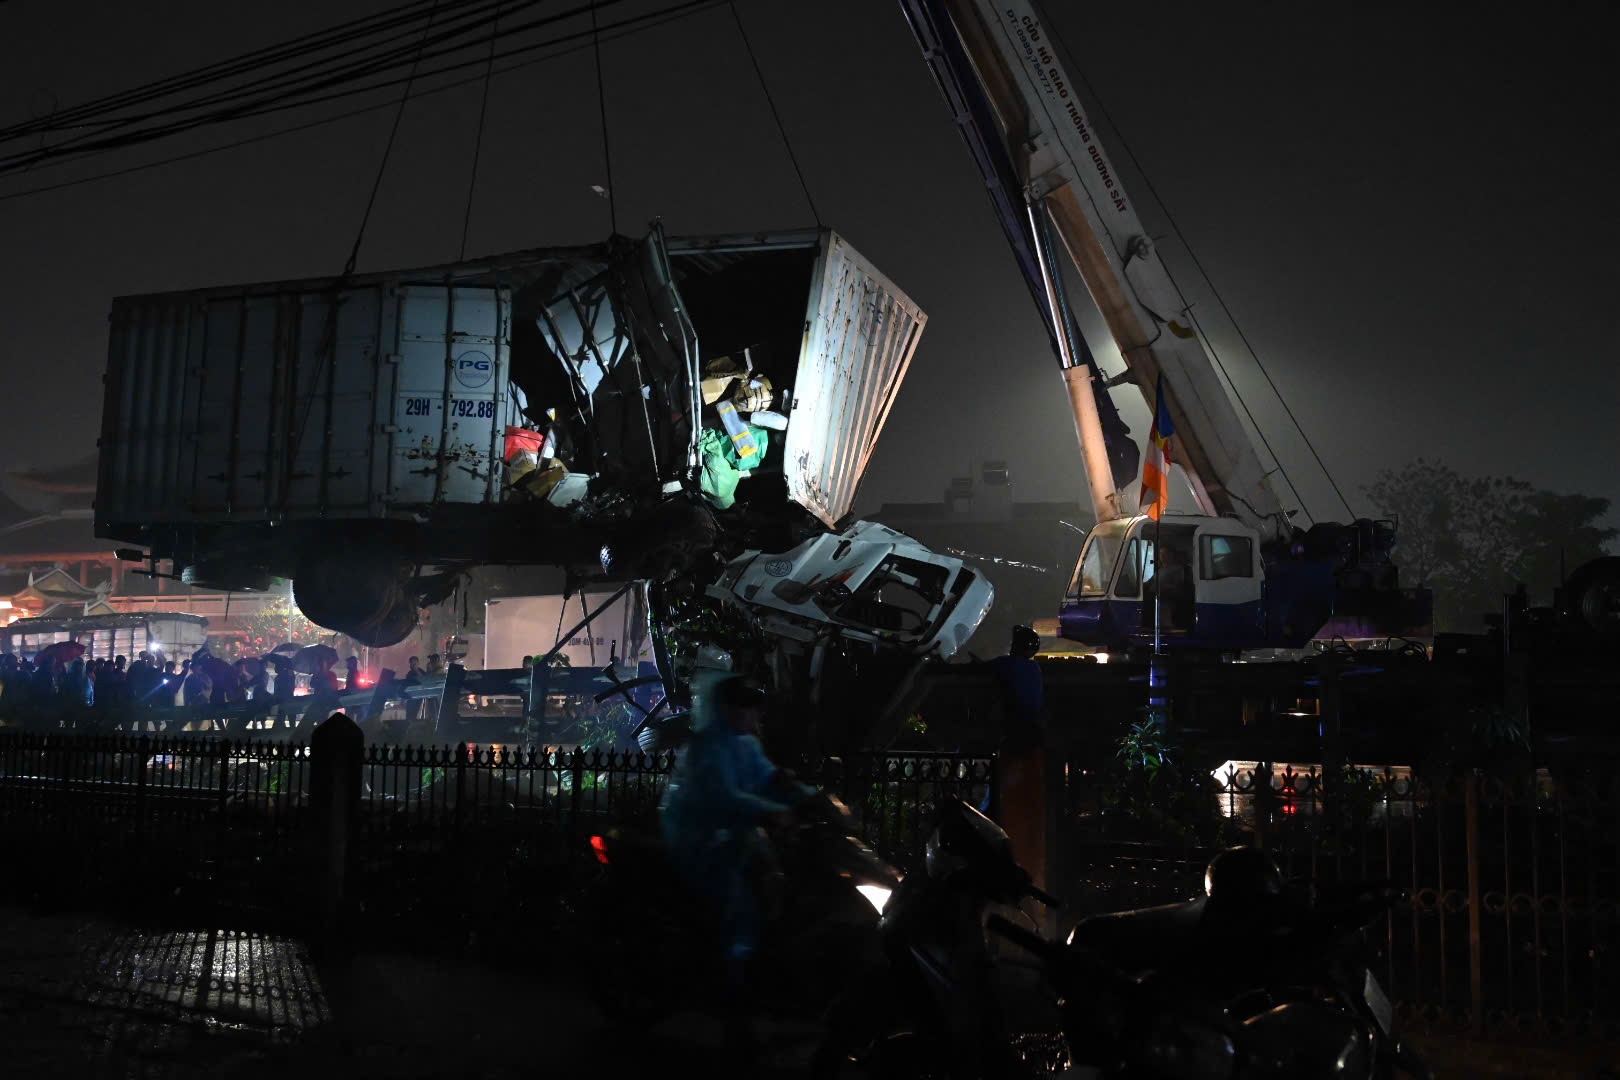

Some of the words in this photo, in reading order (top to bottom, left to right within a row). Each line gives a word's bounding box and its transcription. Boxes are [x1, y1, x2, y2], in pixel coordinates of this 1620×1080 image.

[1049, 68, 1068, 98] GIAO
[1066, 101, 1090, 143] THÔNG
[459, 360, 489, 371] PG
[406, 398, 430, 416] 29H
[451, 400, 494, 418] 792.88
